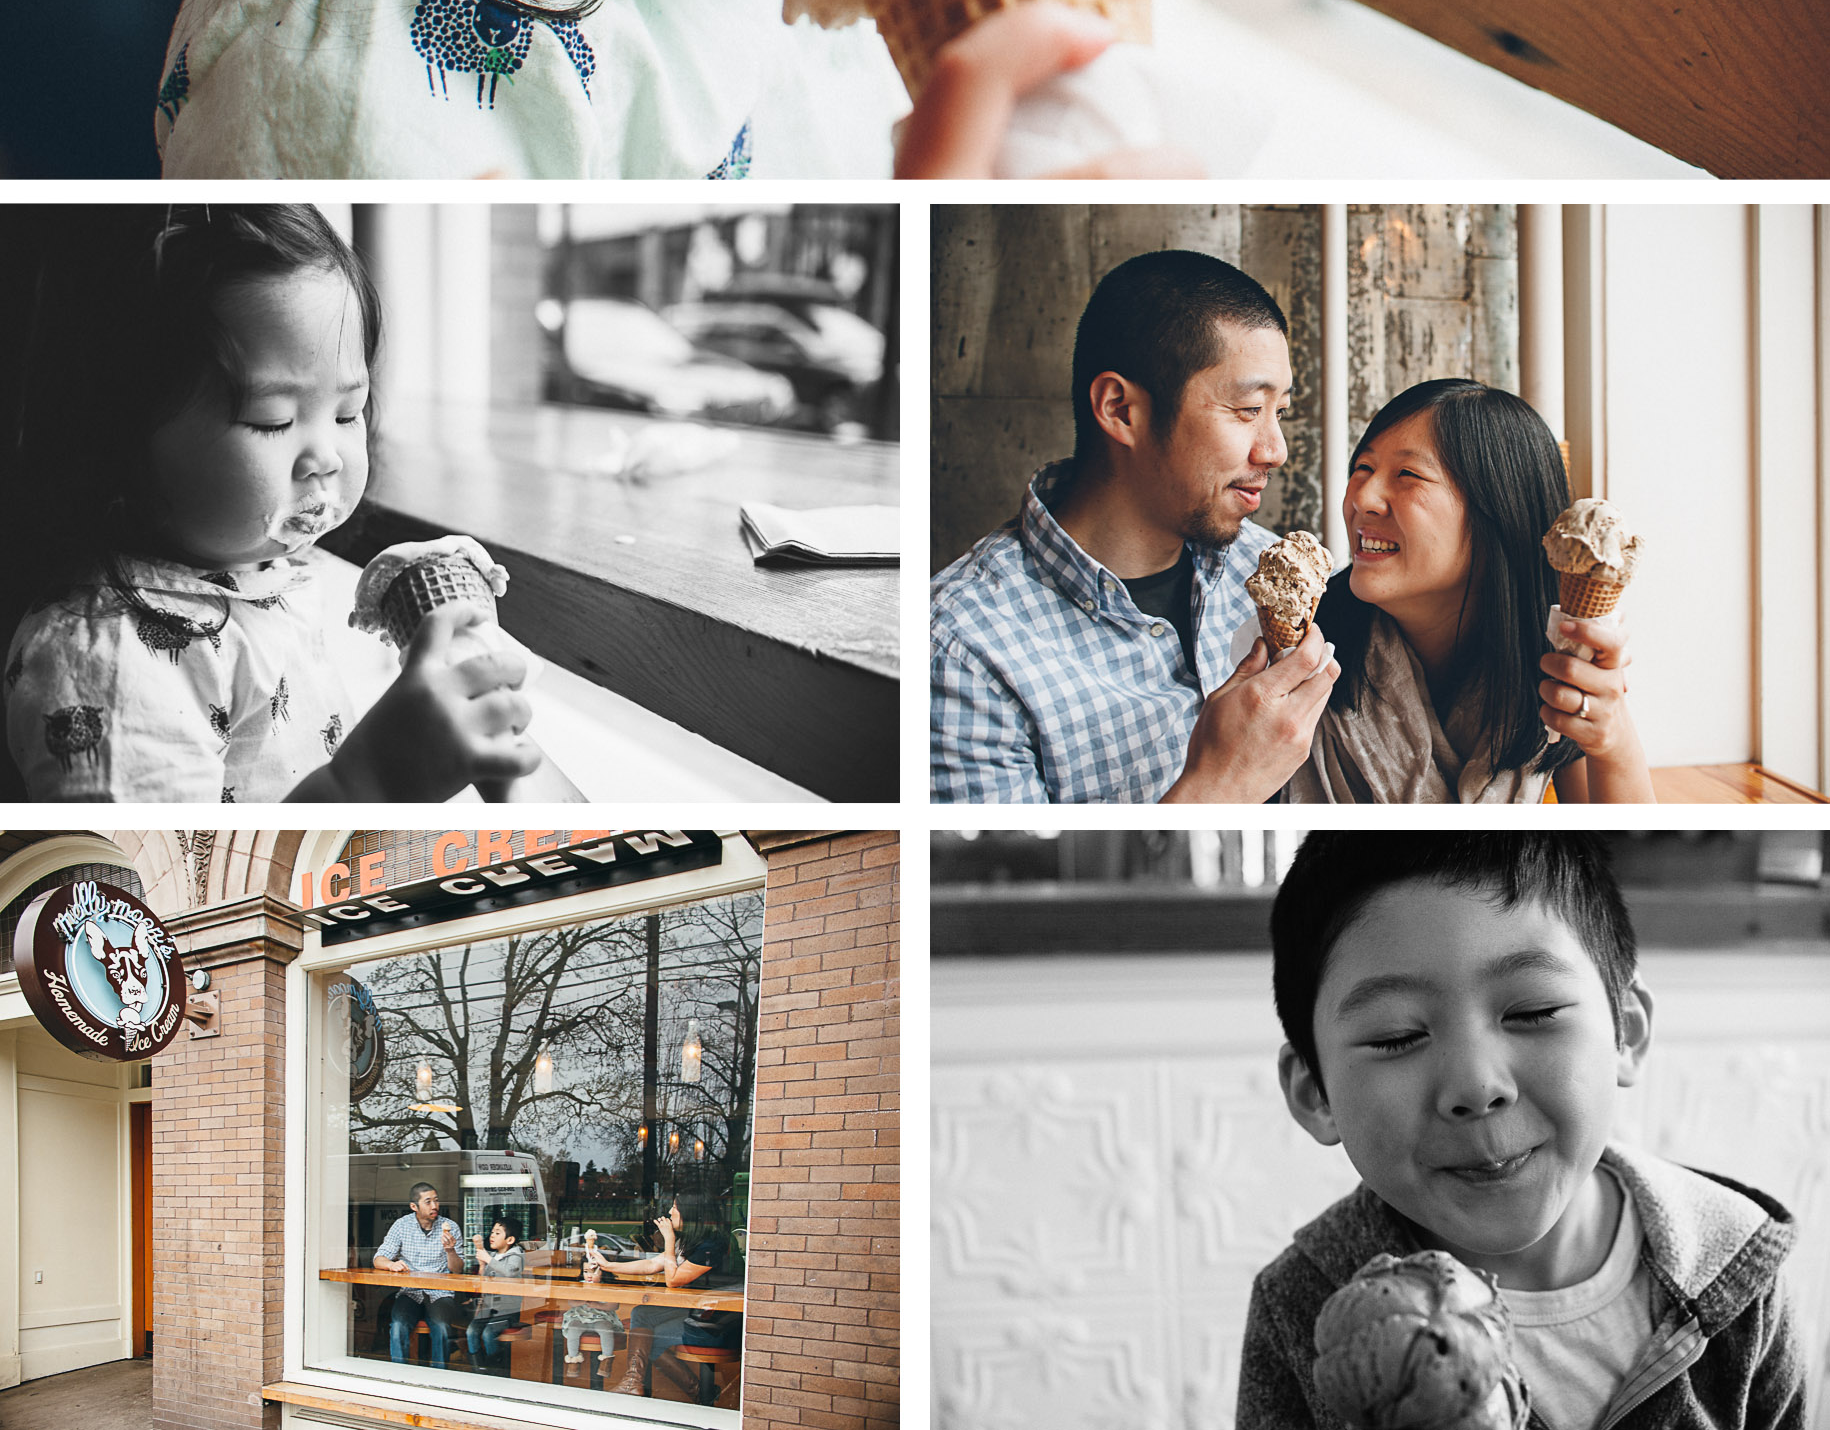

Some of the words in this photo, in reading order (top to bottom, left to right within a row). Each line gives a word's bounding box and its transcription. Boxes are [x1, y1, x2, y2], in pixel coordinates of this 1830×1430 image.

[301, 850, 388, 910] ICE
[432, 830, 628, 878] CRE
[52, 881, 111, 943] molly
[43, 968, 109, 1047] Homemade
[129, 1032, 152, 1052] Ice
[151, 1003, 180, 1042] Cream
